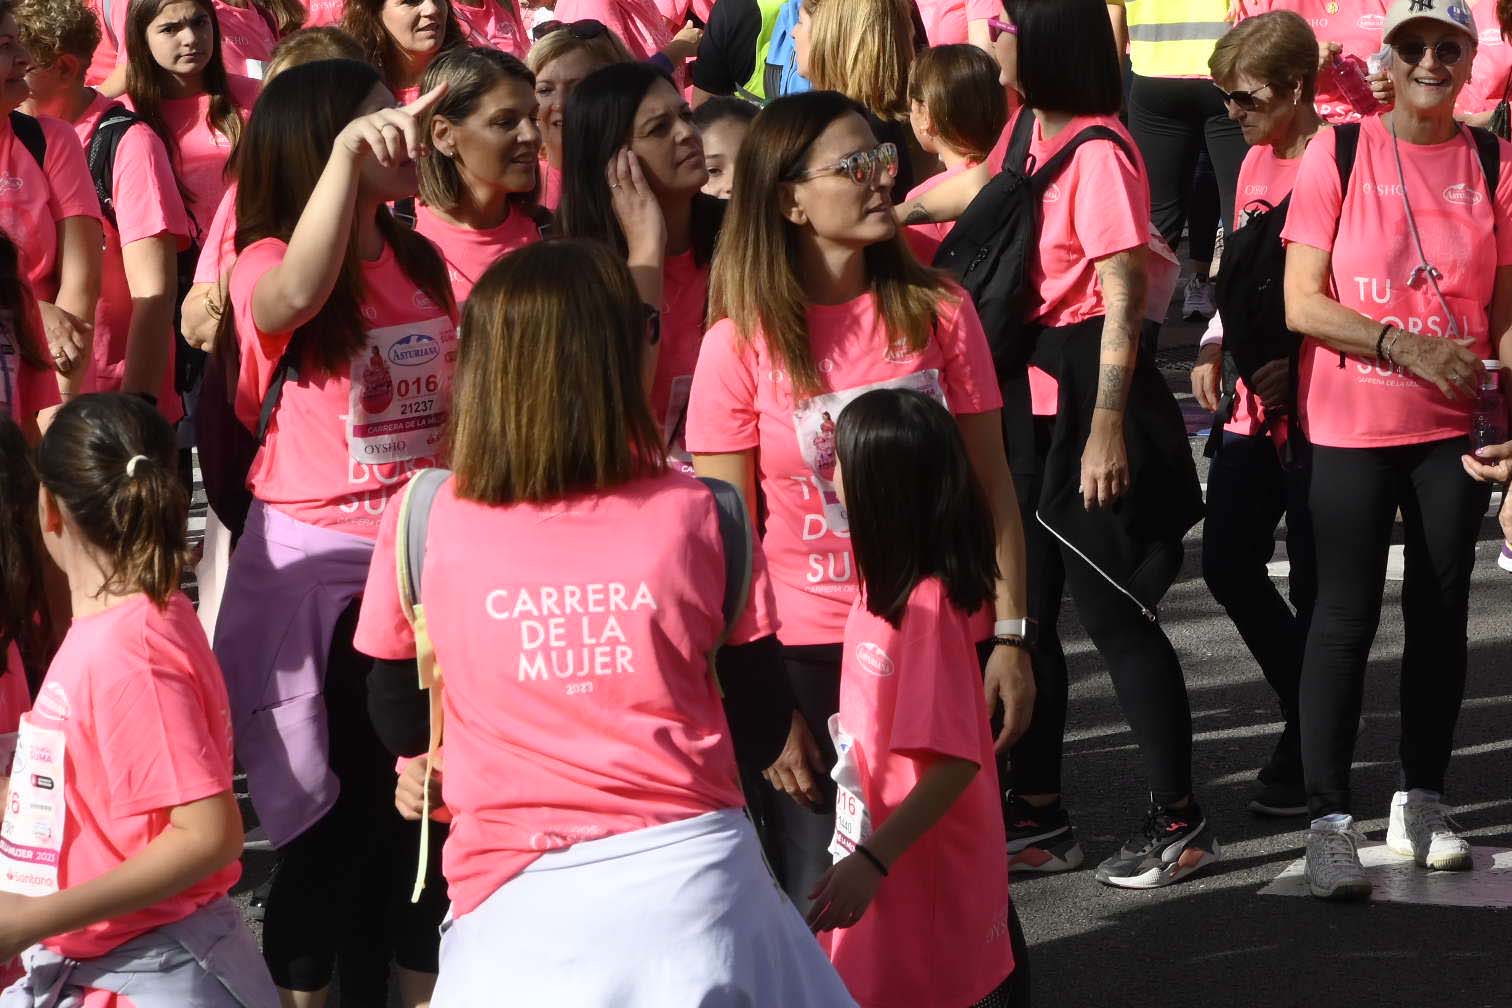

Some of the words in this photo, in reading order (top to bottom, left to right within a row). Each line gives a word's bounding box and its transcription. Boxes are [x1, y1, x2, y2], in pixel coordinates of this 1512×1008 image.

[1354, 276, 1392, 304] TU
[393, 346, 440, 362] ASTURIANA
[397, 374, 438, 398] 016
[400, 399, 435, 416] 21237
[364, 439, 406, 455] OYSHO
[806, 551, 850, 584] SU
[485, 581, 658, 620] CARRERA
[520, 617, 567, 650] DE
[582, 615, 626, 645] LA
[518, 645, 635, 682] MUJER
